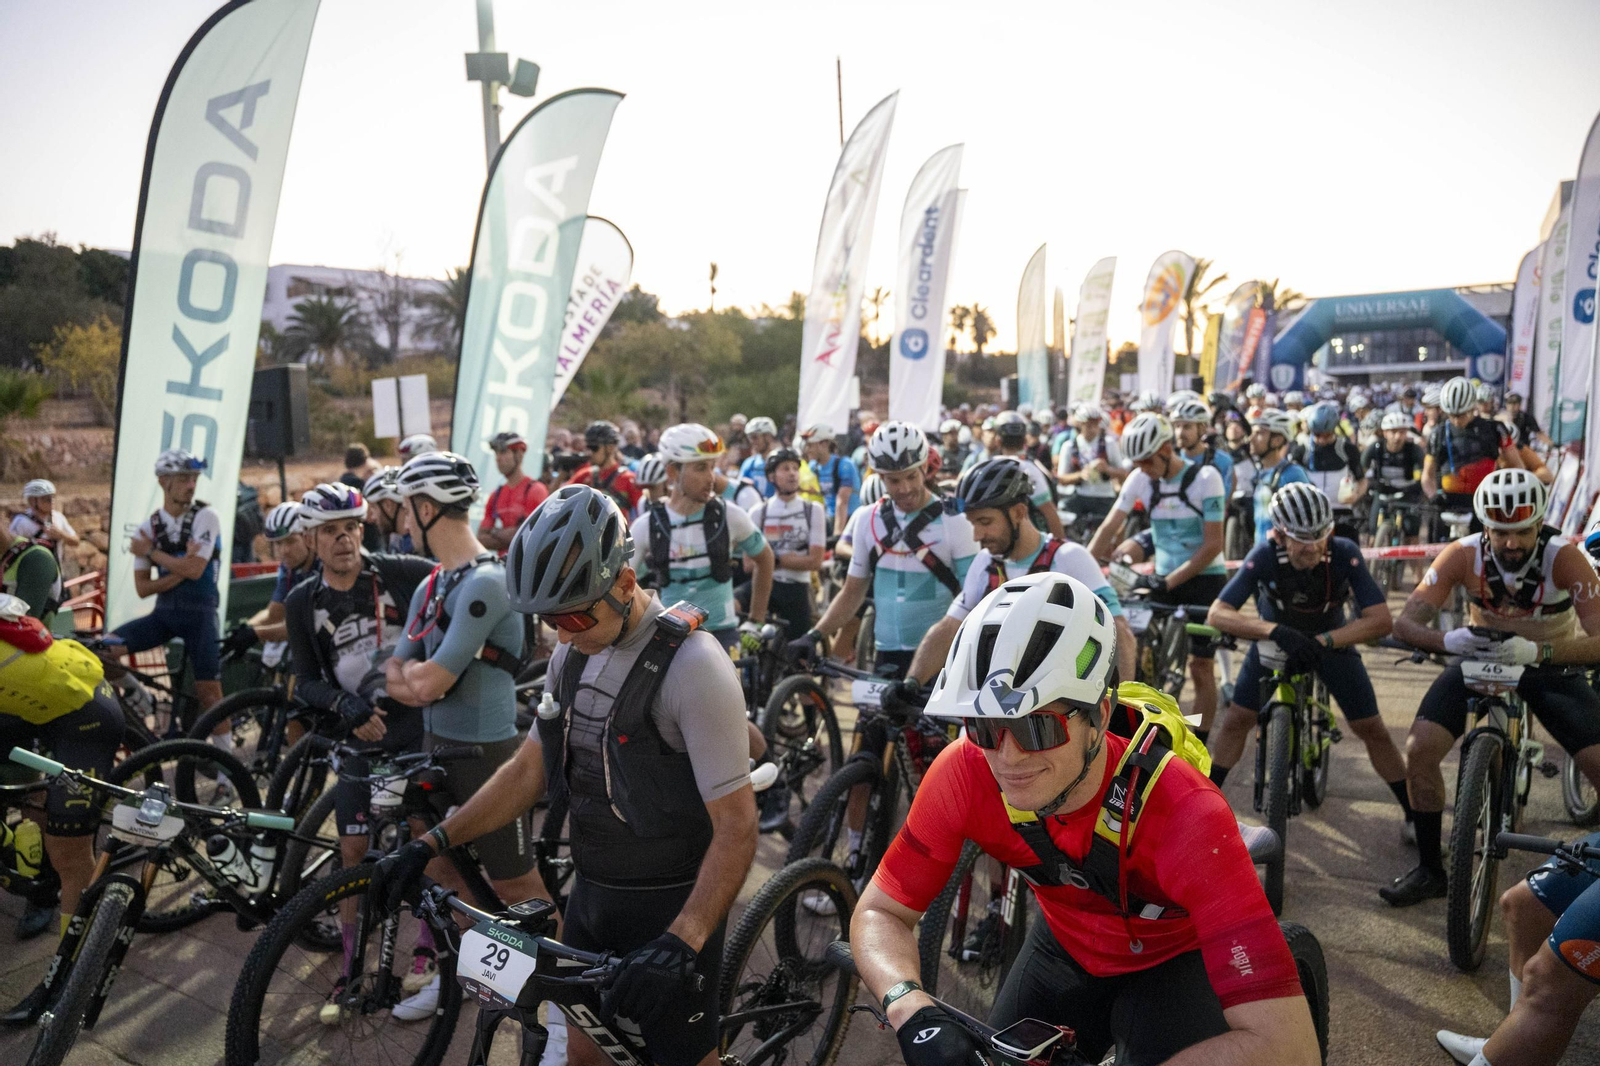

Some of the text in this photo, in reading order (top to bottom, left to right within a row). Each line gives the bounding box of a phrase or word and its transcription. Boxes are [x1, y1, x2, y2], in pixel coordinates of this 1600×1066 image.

[912, 204, 939, 320] Cleardent
[582, 263, 602, 288] DE
[1335, 298, 1431, 316] UNIVERSAE
[557, 279, 621, 371] ALMERÍA
[1482, 663, 1503, 675] 46
[129, 826, 159, 837] ANTONIO
[487, 927, 523, 950] SKODA
[480, 943, 510, 972] 29
[481, 969, 497, 981] JAVI
